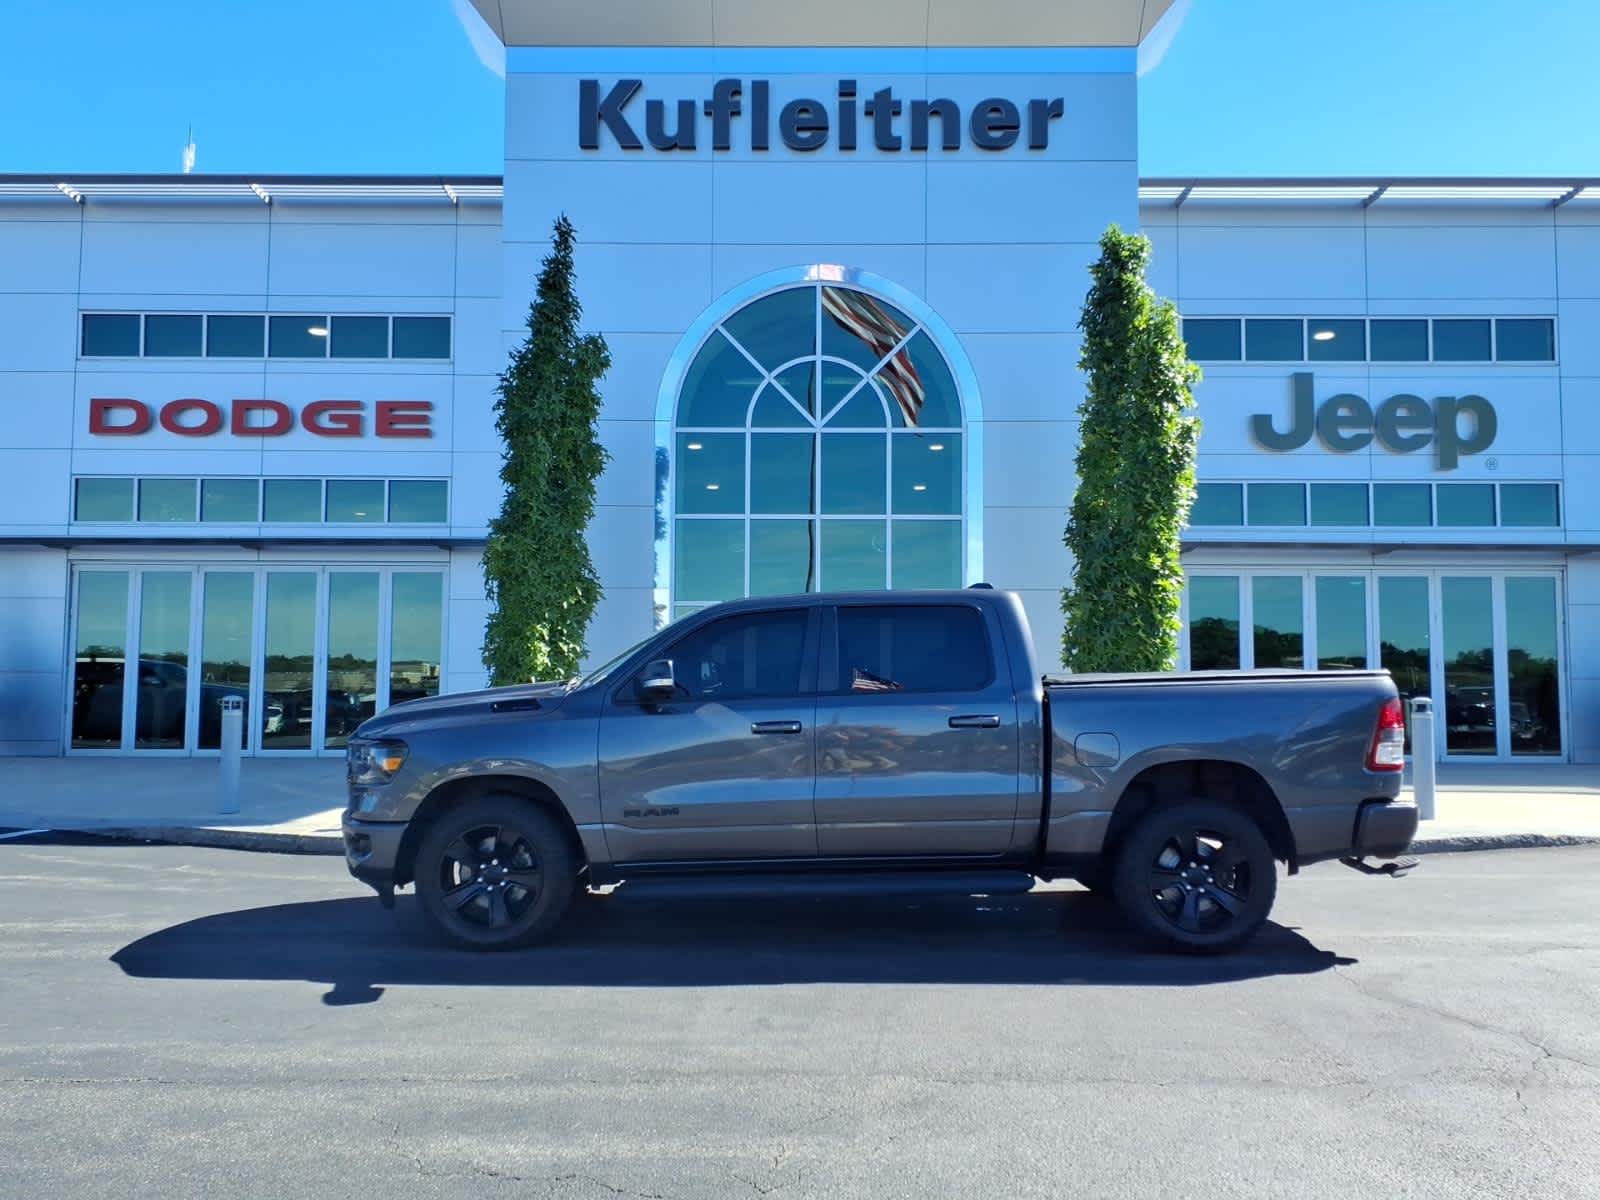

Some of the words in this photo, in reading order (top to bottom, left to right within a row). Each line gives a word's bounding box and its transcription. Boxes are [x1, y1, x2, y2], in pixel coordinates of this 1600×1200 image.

[579, 79, 1064, 151] Kufleitner
[89, 398, 432, 437] DODGE
[1251, 372, 1497, 470] Jeep
